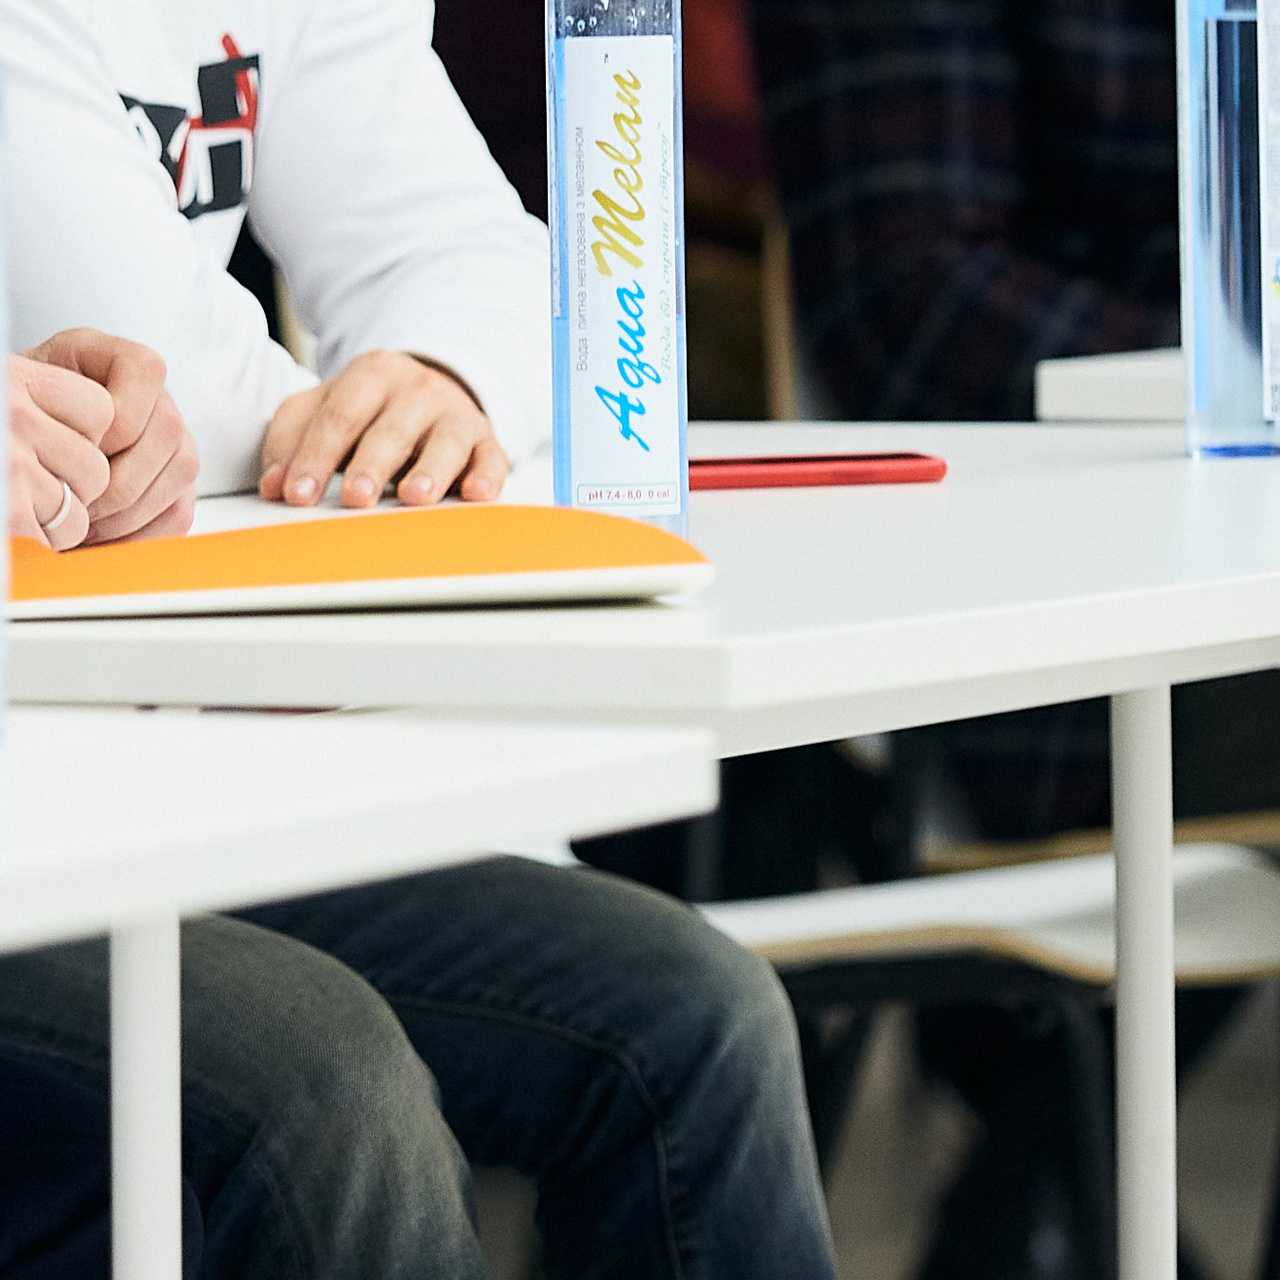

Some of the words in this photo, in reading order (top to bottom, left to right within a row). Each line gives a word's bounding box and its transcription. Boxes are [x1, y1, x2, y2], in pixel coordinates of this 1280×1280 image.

[589, 69, 646, 277] Melan
[576, 338, 588, 371] Вода
[594, 279, 662, 453] Aqua
[588, 490, 603, 501] pH
